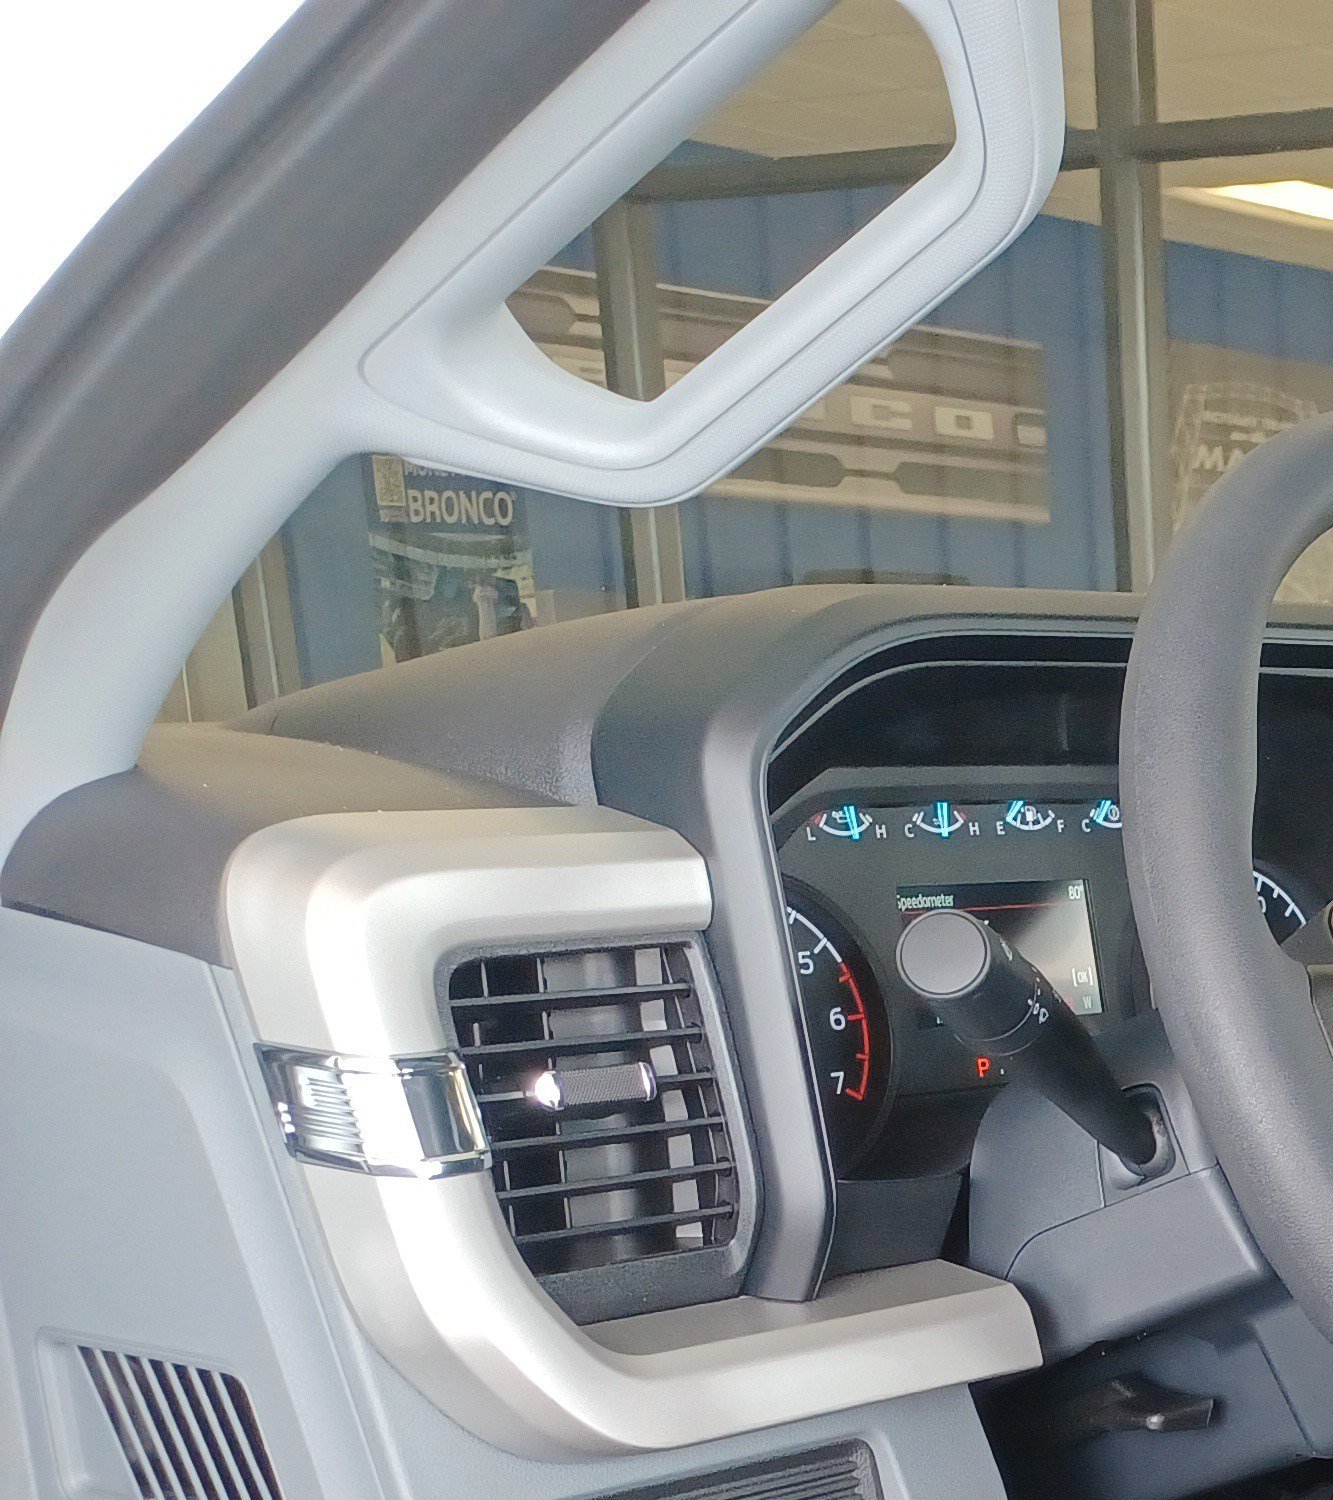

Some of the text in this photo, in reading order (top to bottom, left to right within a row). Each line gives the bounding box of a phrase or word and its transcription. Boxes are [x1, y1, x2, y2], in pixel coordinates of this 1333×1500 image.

[407, 489, 513, 526] BRONCO
[876, 825, 887, 839] H
[904, 824, 915, 838] C
[969, 822, 980, 836] H
[996, 821, 1006, 835] E
[1056, 819, 1065, 833] F
[1081, 818, 1092, 833] C
[797, 951, 815, 975] 5
[829, 1007, 846, 1031] 6
[975, 1056, 991, 1079] P
[830, 1071, 845, 1095] 7
